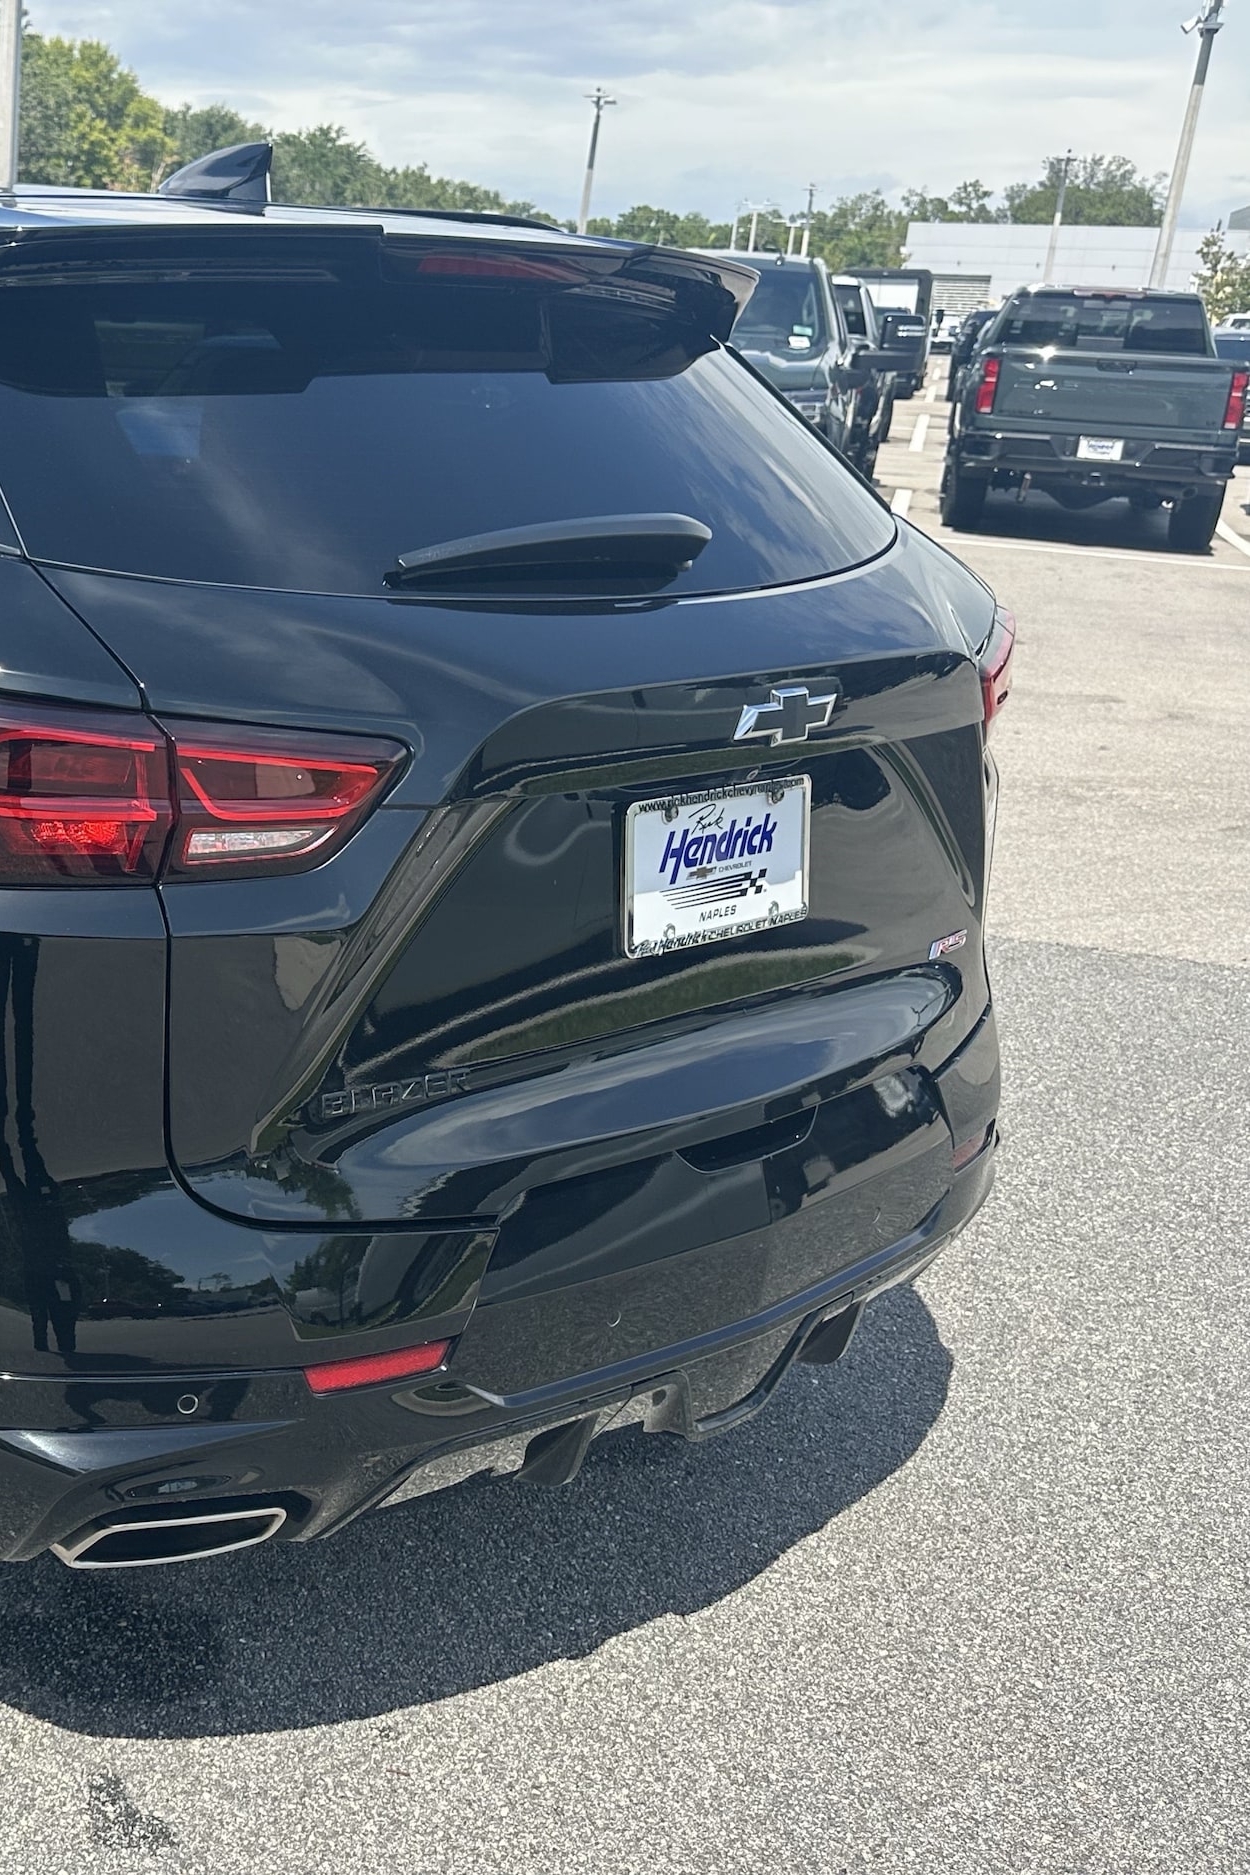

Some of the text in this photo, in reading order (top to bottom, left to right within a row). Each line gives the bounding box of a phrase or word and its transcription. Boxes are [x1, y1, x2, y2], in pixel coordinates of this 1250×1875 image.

[659, 813, 778, 885] Hendrick
[718, 860, 753, 873] CHEVROLET
[699, 905, 738, 922] NAPLES
[929, 929, 968, 960] RS
[321, 1068, 472, 1119] BLAZER
